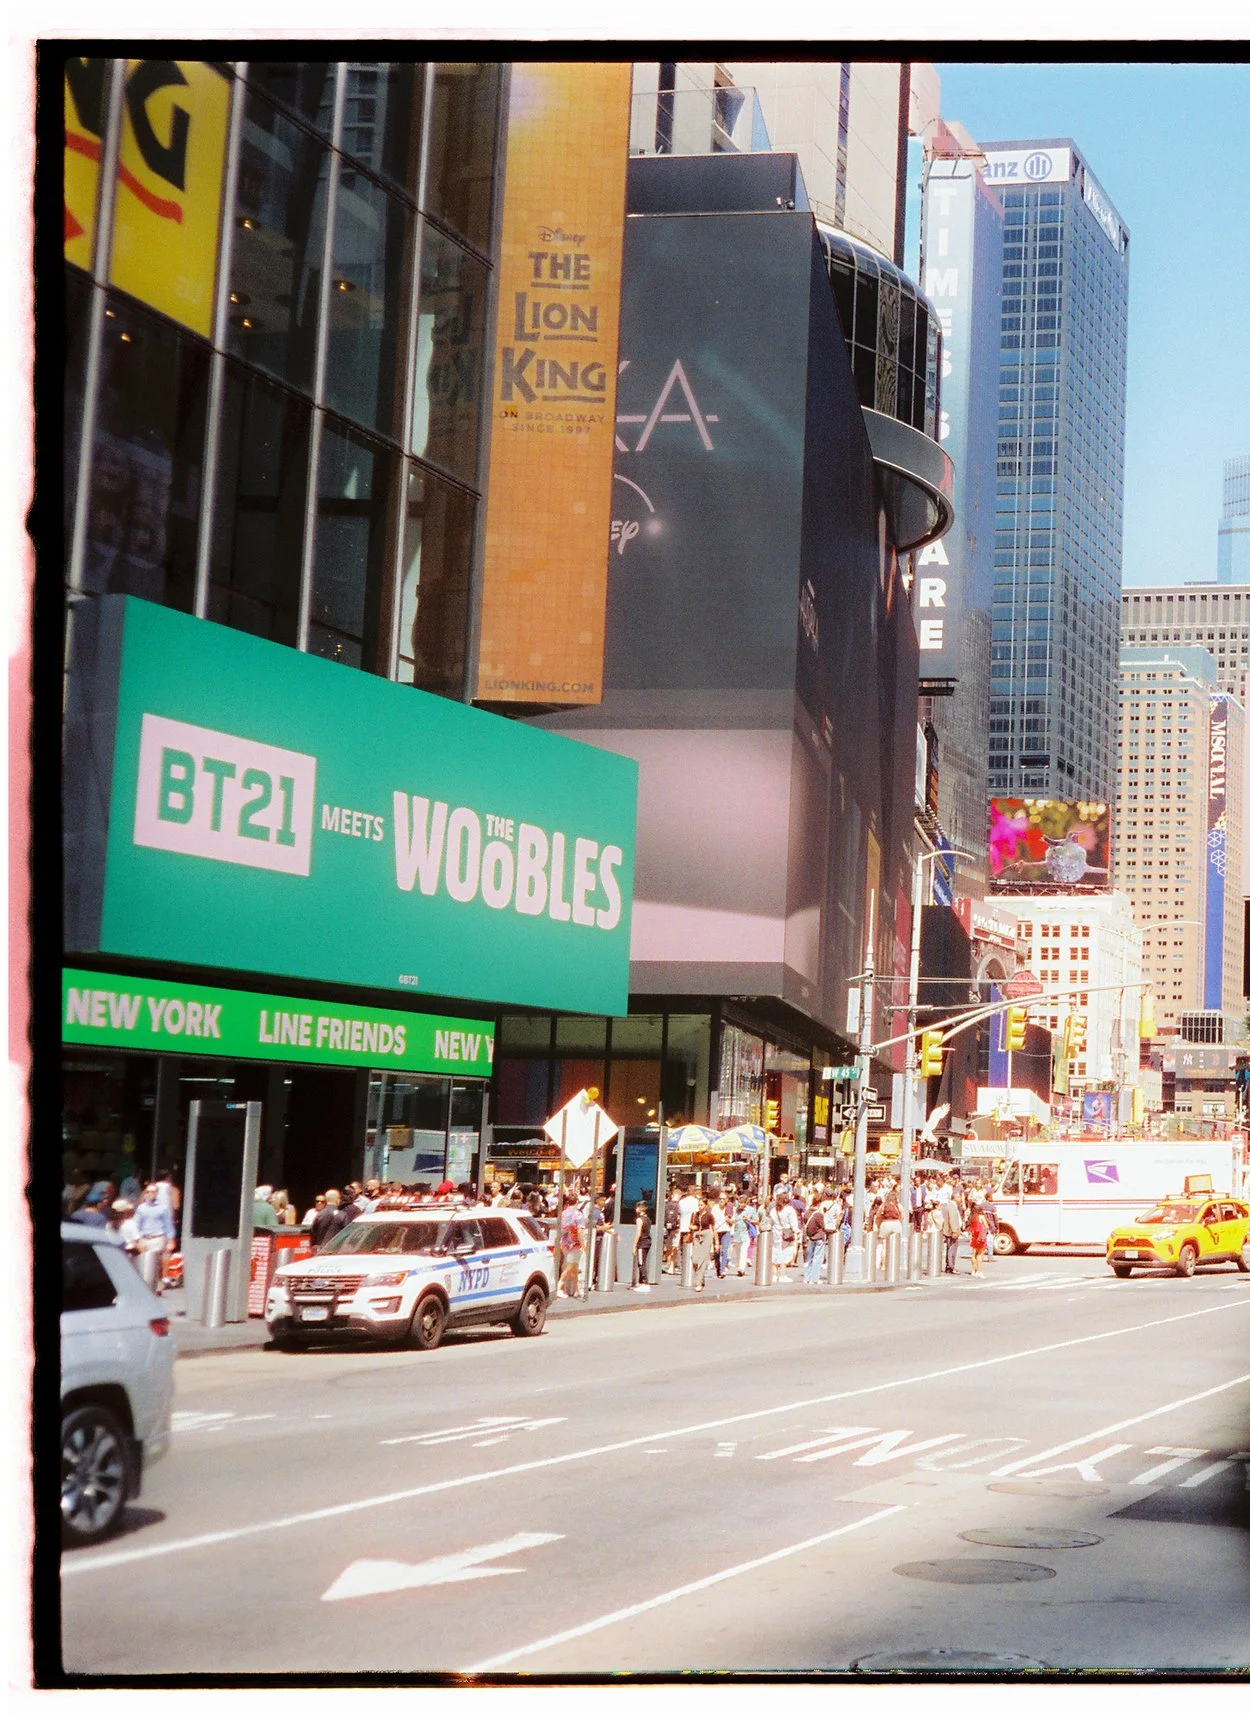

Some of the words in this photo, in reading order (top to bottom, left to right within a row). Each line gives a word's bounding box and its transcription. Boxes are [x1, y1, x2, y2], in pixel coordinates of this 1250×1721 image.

[536, 225, 586, 248] Disney
[528, 251, 592, 281] THE
[514, 292, 598, 343] LION
[501, 347, 607, 404] KING
[500, 410, 518, 419] ON
[525, 411, 605, 425] BROADWAY
[512, 423, 554, 433] SINCE
[560, 425, 591, 435] 1997
[484, 680, 594, 693] LIONKING.COM
[155, 746, 298, 848] BT21
[321, 803, 384, 843] MEETS
[486, 813, 515, 842] THE
[65, 987, 142, 1031] NEW
[147, 996, 222, 1039] YORK
[259, 1009, 312, 1048] LINE
[316, 1016, 406, 1056] FRIENDS
[434, 1029, 480, 1063] NEW
[458, 1267, 490, 1293] NYPD
